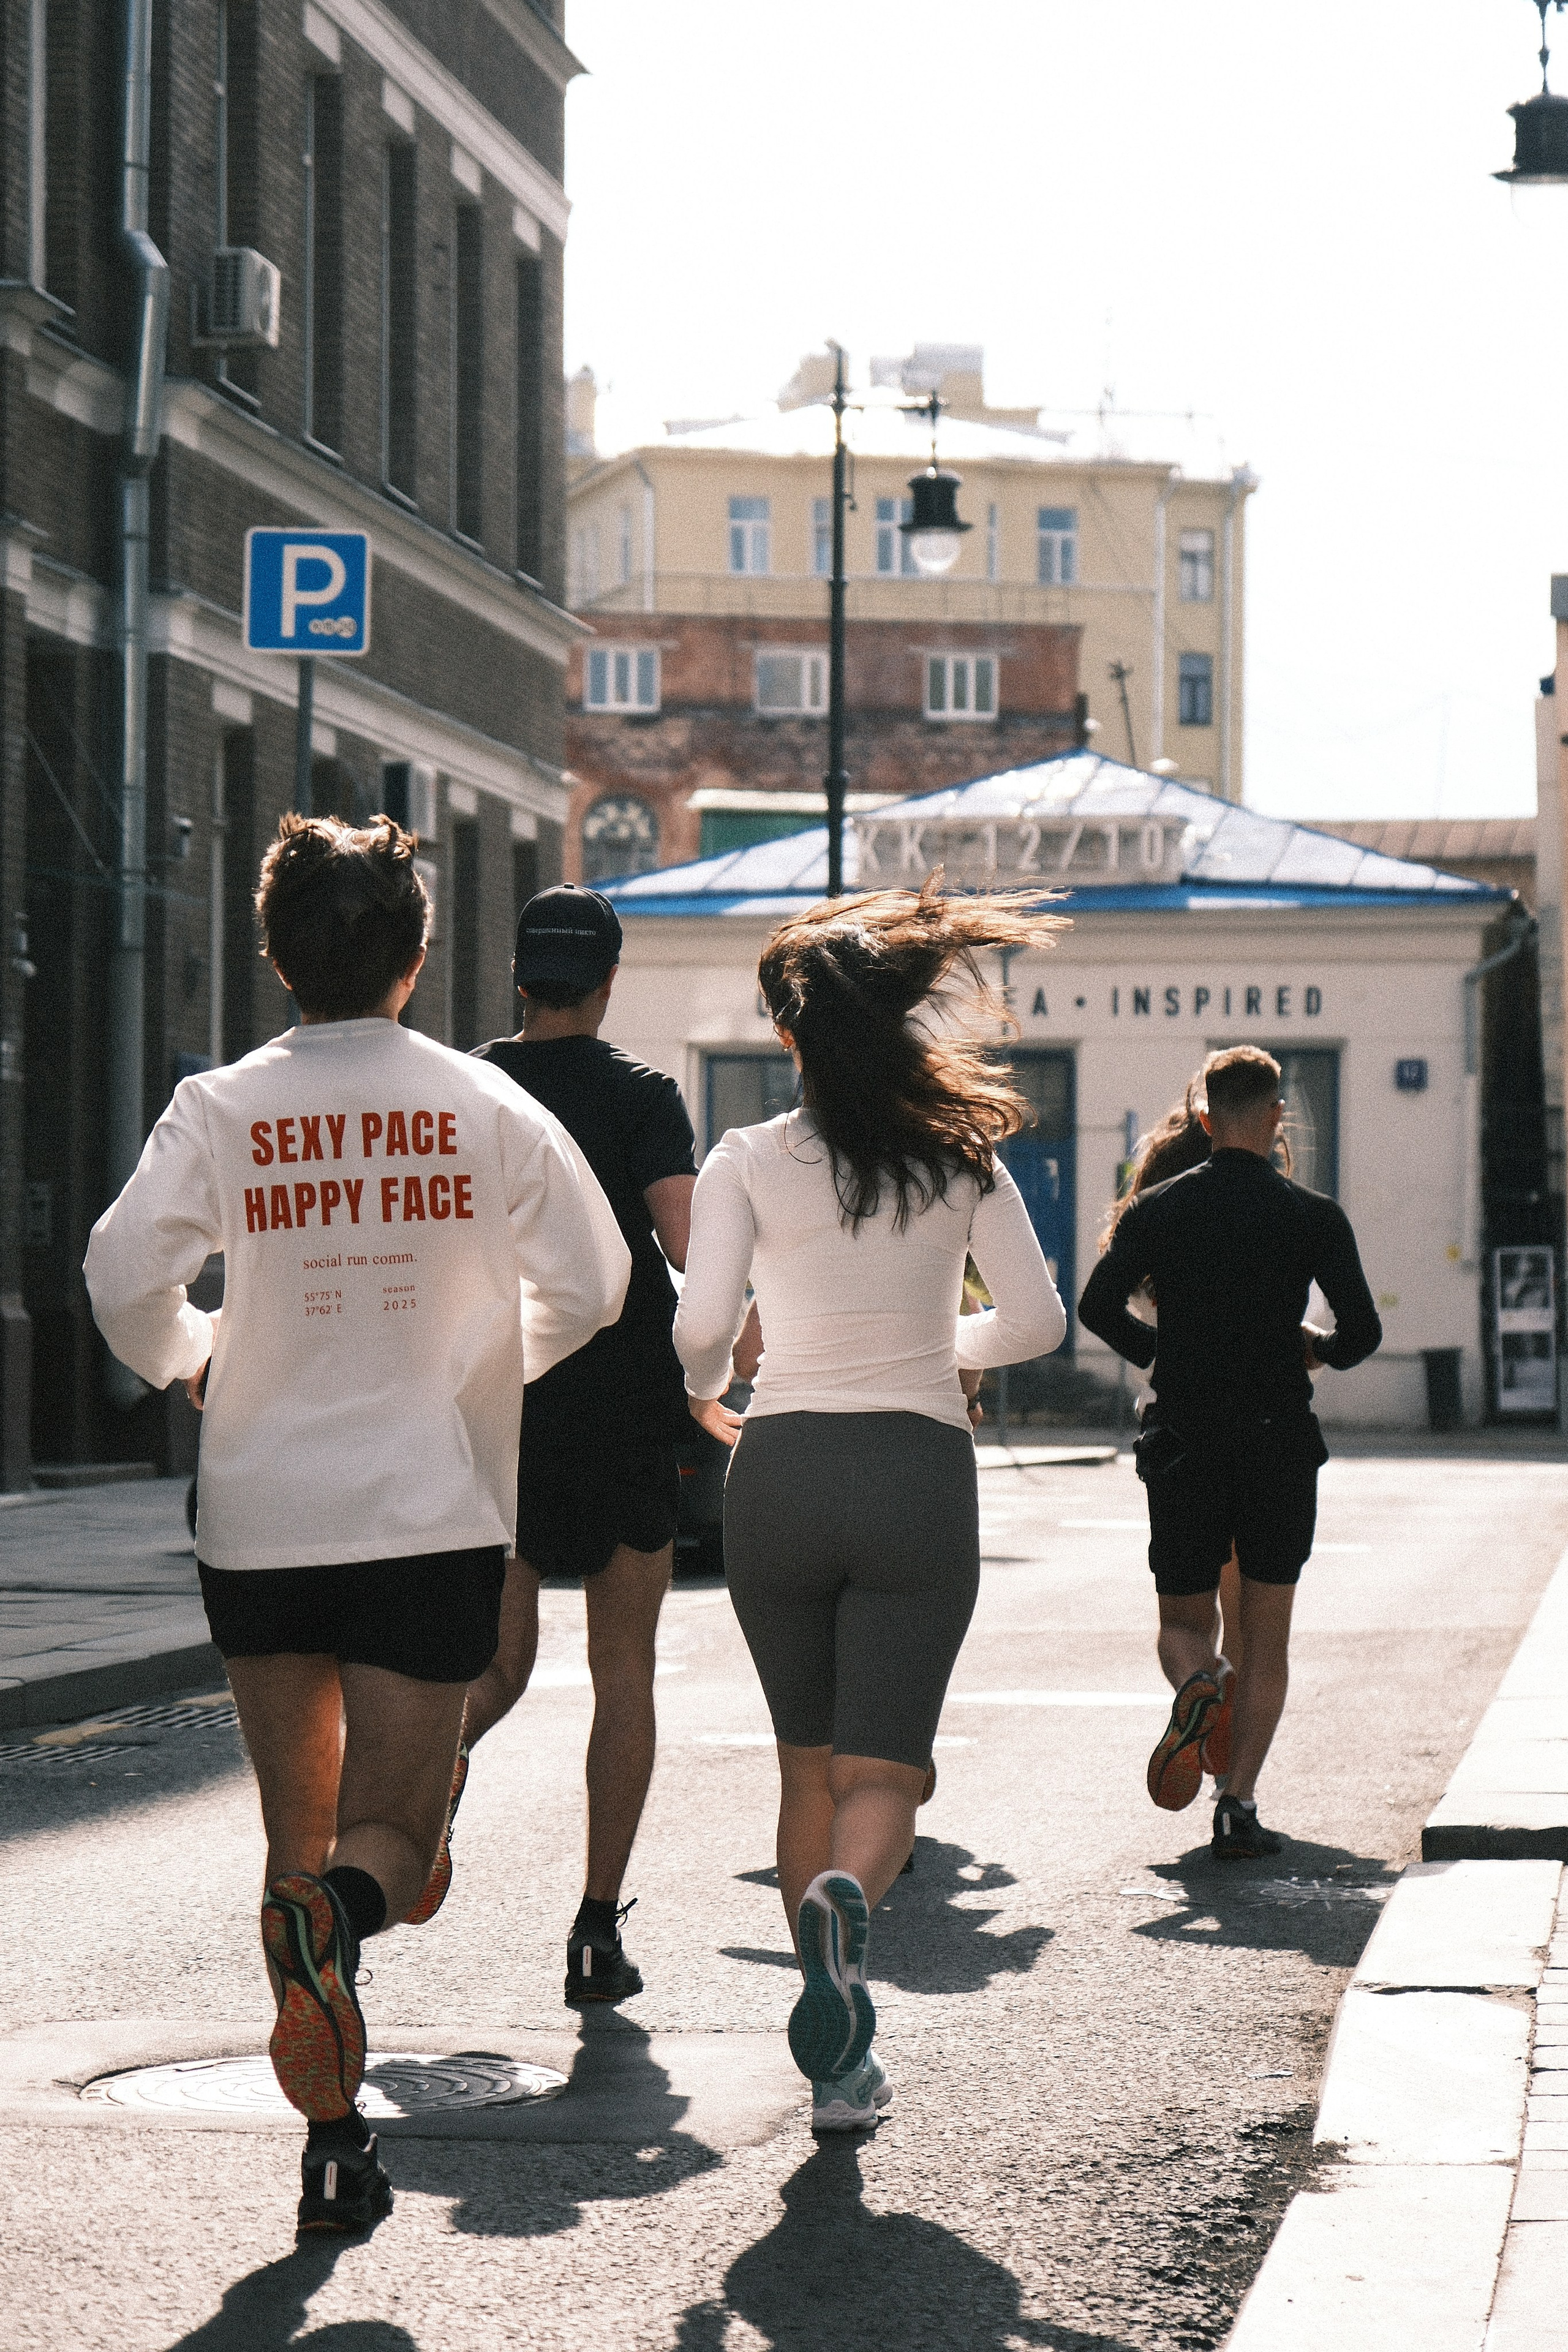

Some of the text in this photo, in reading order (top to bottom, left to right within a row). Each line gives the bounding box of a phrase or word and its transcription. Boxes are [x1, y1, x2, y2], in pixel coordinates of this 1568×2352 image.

[281, 545, 346, 638] P
[982, 822, 1166, 872] 12/10
[1112, 984, 1322, 1017] INSPIRED
[251, 1110, 457, 1166] SEXY PACE
[244, 1174, 473, 1233] HAPPY FACE
[303, 1253, 418, 1270] social run comm.
[335, 1289, 342, 1298] N
[382, 1284, 415, 1294] season
[337, 1303, 342, 1313] E
